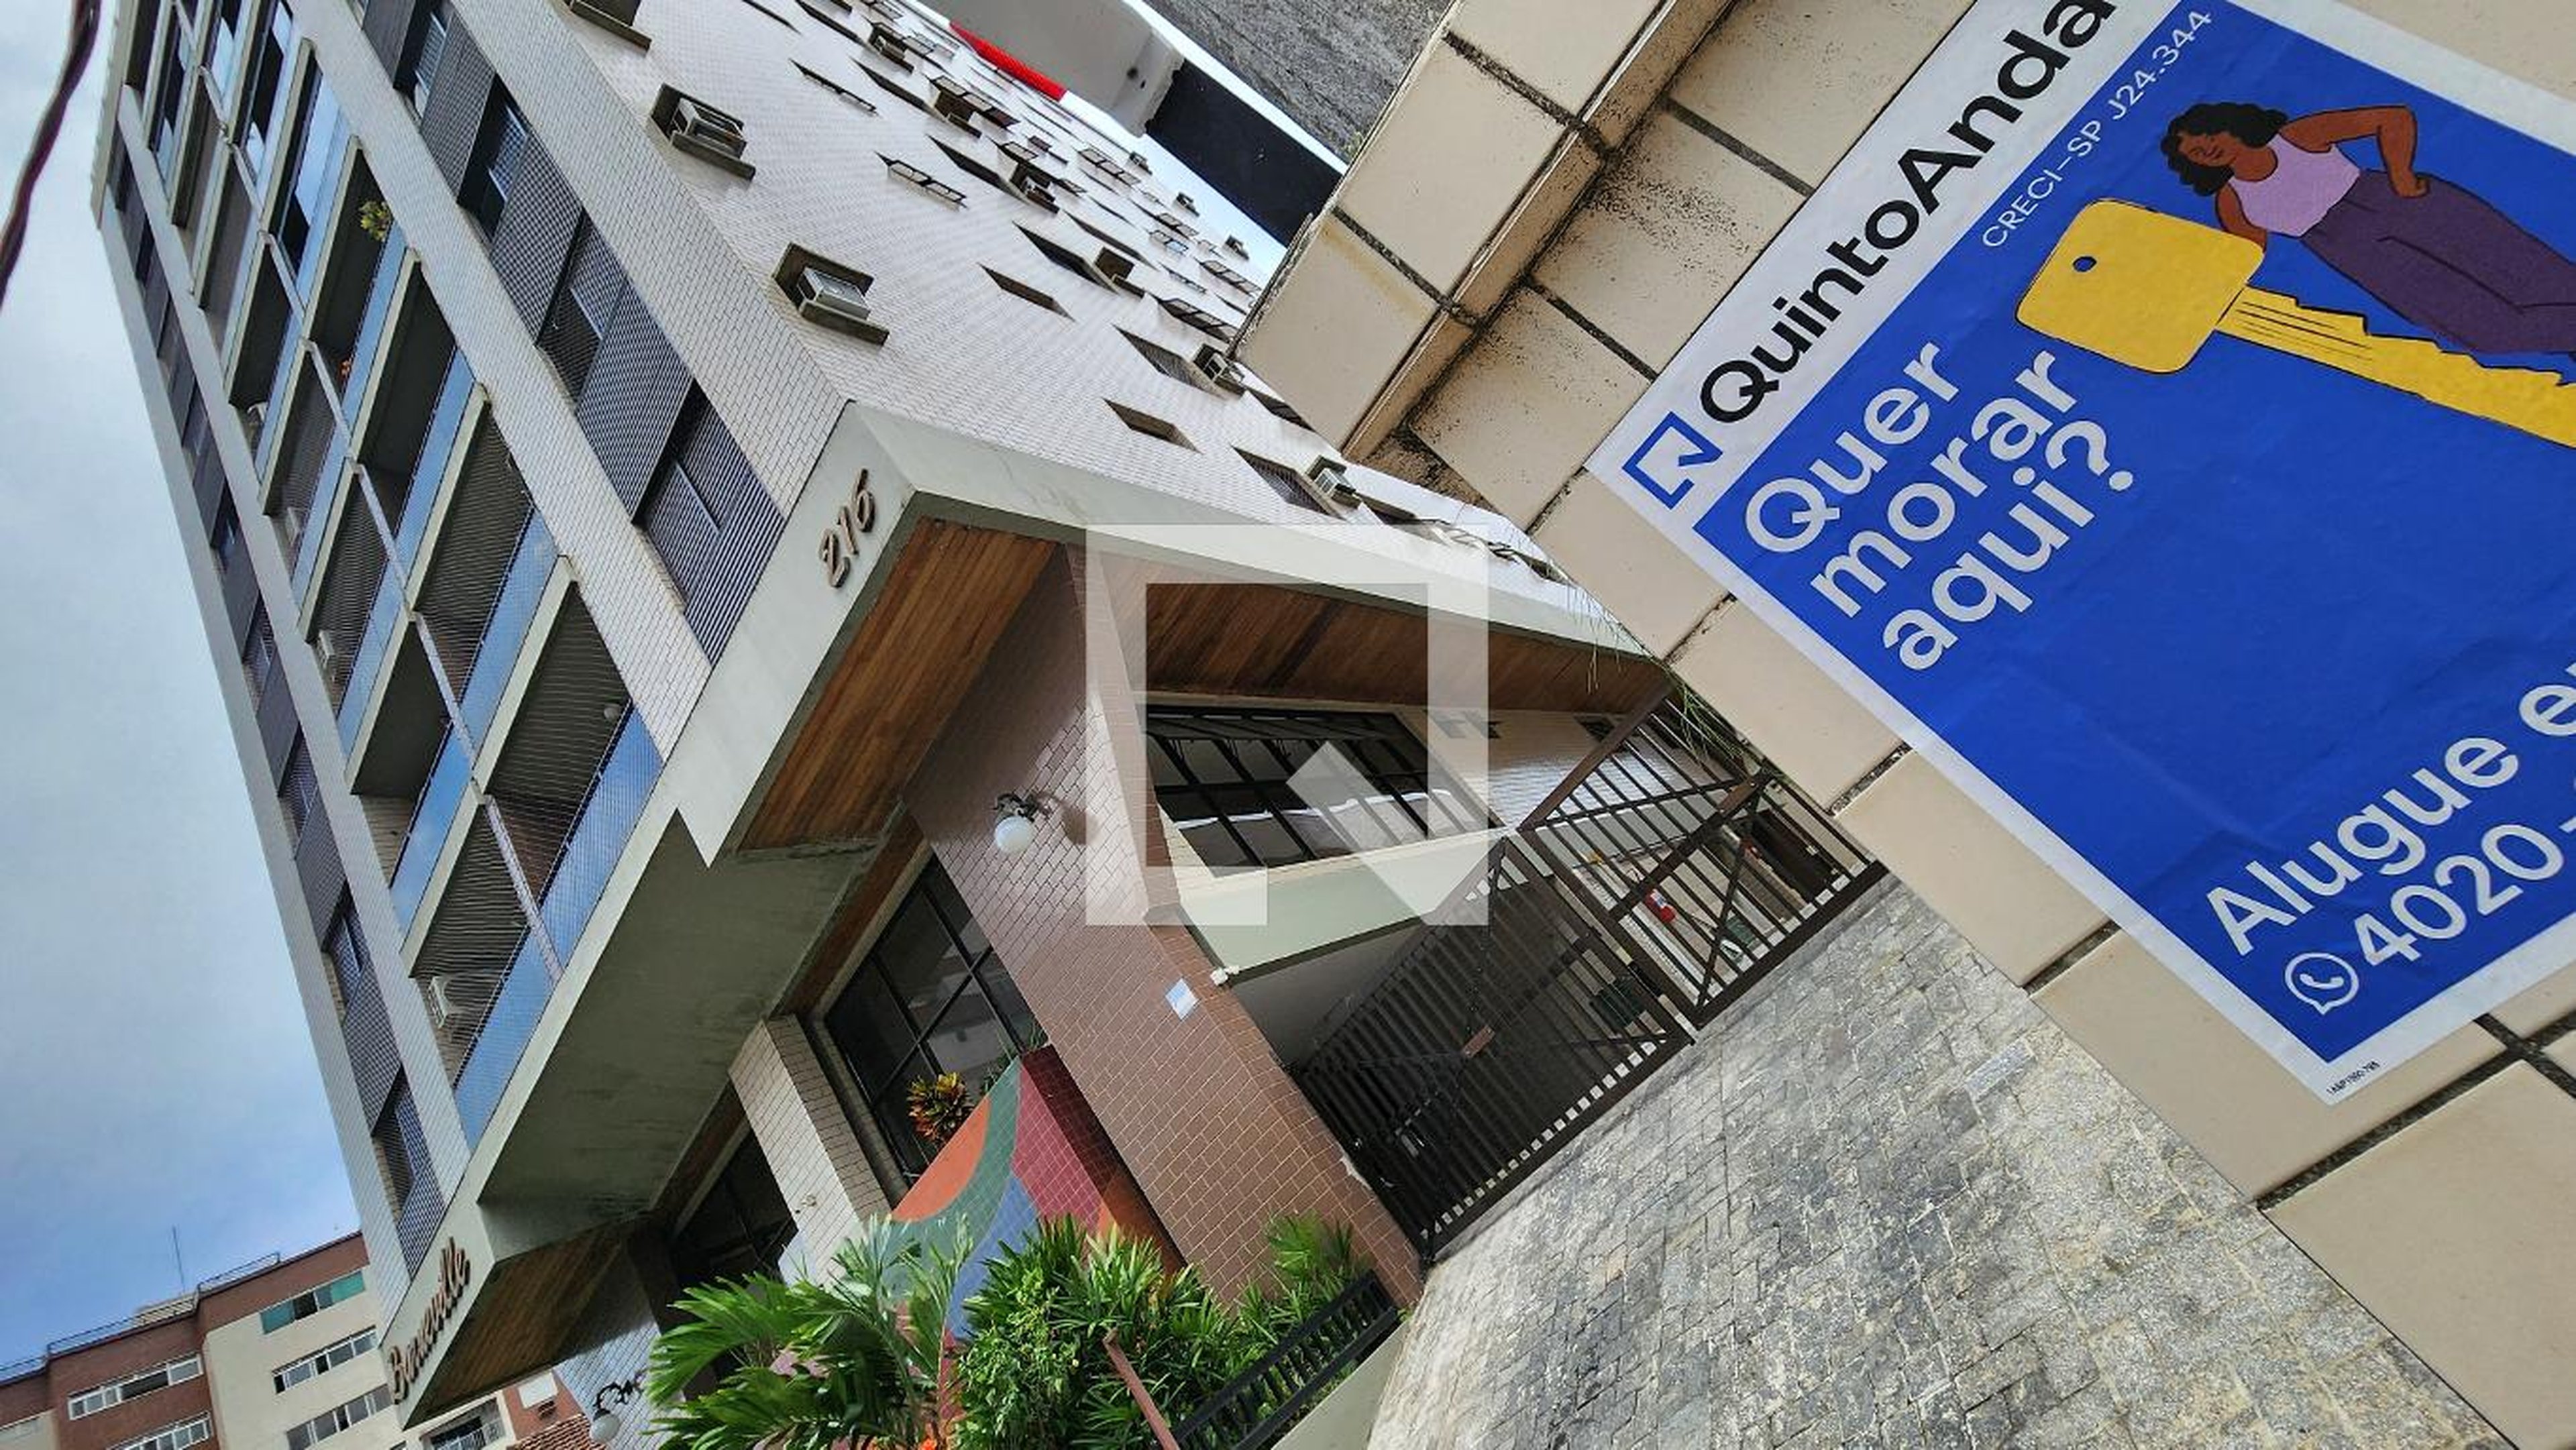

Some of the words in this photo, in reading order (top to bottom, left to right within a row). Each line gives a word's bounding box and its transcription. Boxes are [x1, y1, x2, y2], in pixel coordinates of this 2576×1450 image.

[2107, 11, 2212, 120] J24.344
[819, 468, 875, 588] 216
[1744, 341, 1962, 554] Quer
[1810, 350, 2078, 618] morar
[1882, 419, 2135, 671] aqui?
[2206, 735, 2518, 956] Alugue
[2518, 662, 2576, 737] e
[2353, 776, 2576, 968] 4020-
